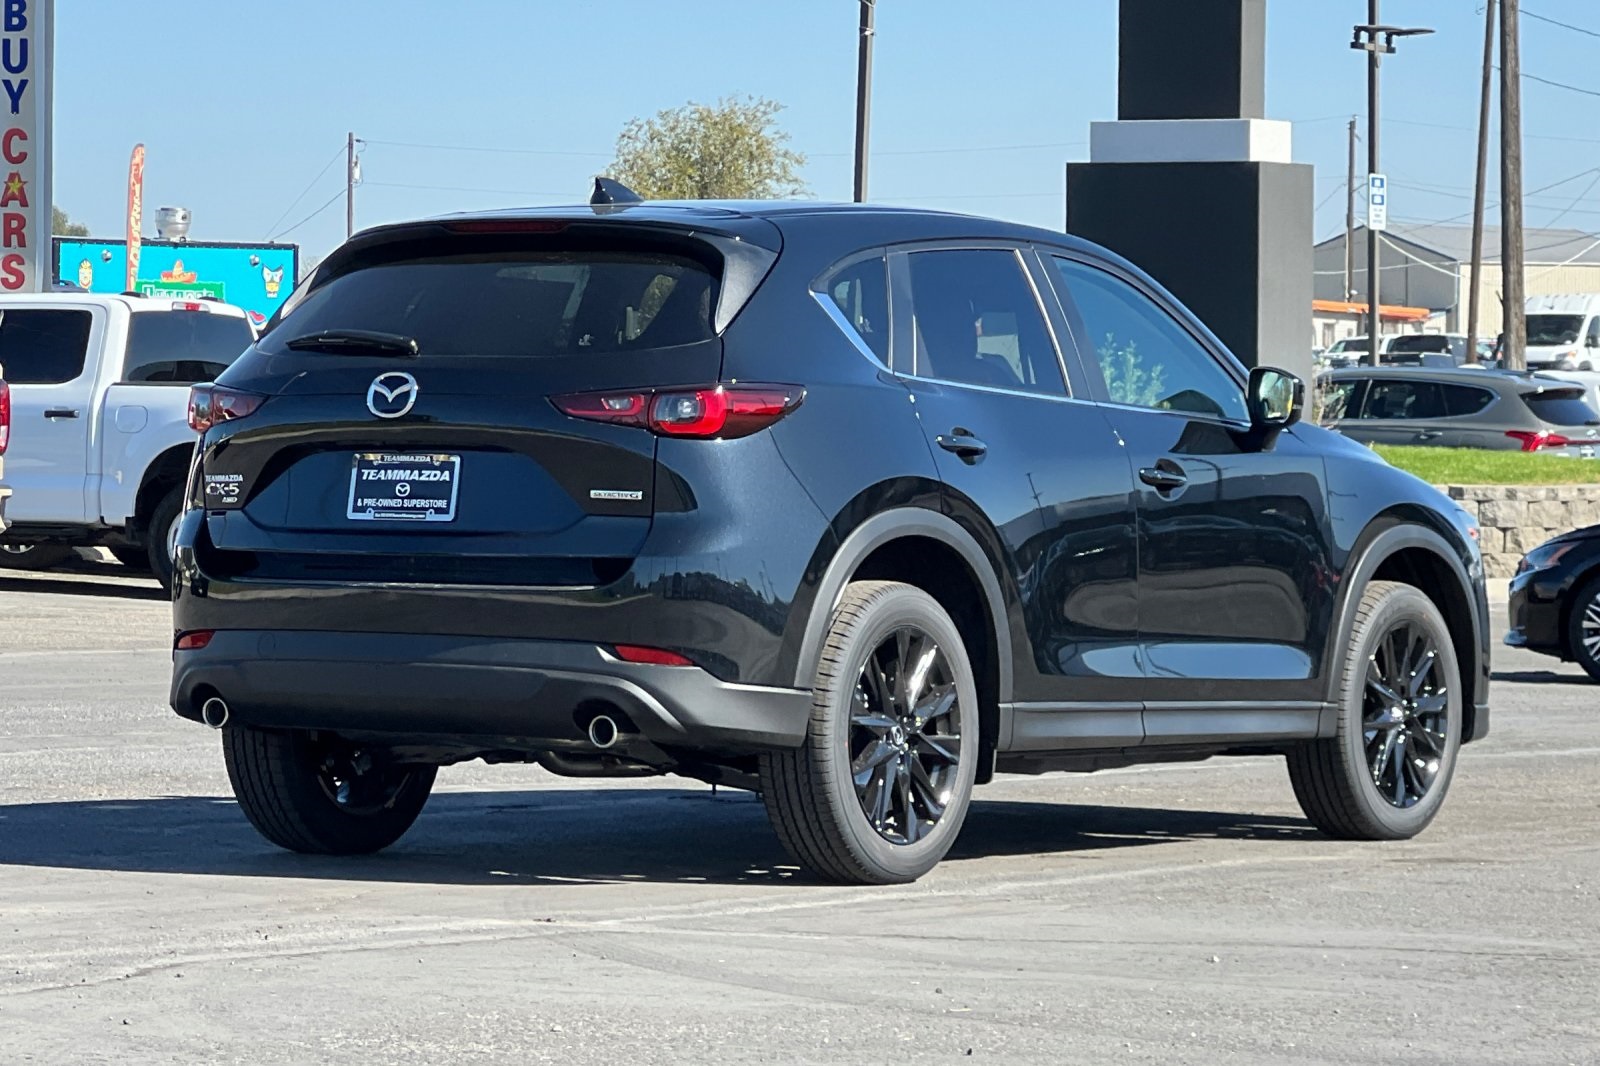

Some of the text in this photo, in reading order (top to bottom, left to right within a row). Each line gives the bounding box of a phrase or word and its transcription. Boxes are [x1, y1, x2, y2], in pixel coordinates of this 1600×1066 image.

[0, 0, 29, 290] BUY CARS
[383, 455, 431, 463] TEAMMAZDA
[205, 474, 243, 482] TEAMMAZDA
[361, 469, 450, 481] TEAMMAZDA
[206, 482, 240, 495] CX-5
[357, 498, 448, 508] & PRE-OWNED SUPERSTORE
